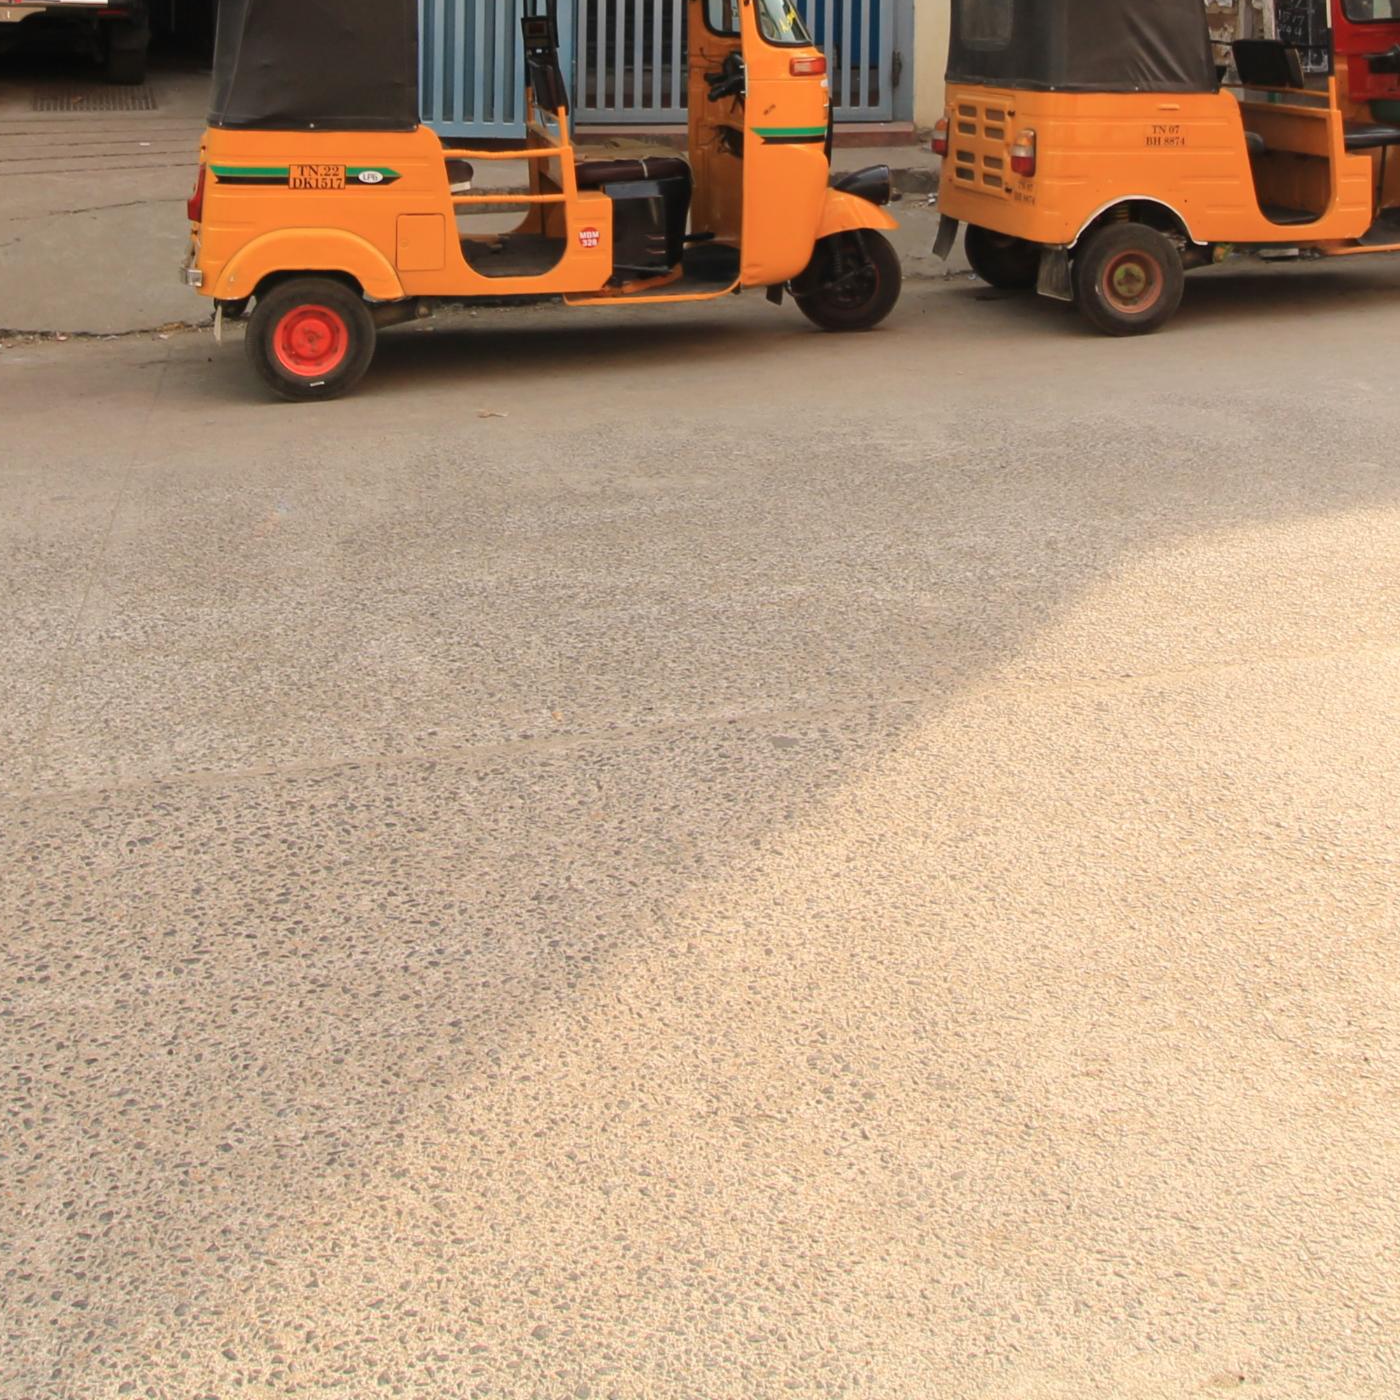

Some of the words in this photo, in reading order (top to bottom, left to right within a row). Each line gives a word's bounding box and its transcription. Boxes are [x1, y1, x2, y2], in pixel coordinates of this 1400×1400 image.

[1152, 125, 1166, 134] TN
[1169, 125, 1180, 134] 07
[1146, 136, 1161, 146] BH
[293, 178, 343, 189] DK1517
